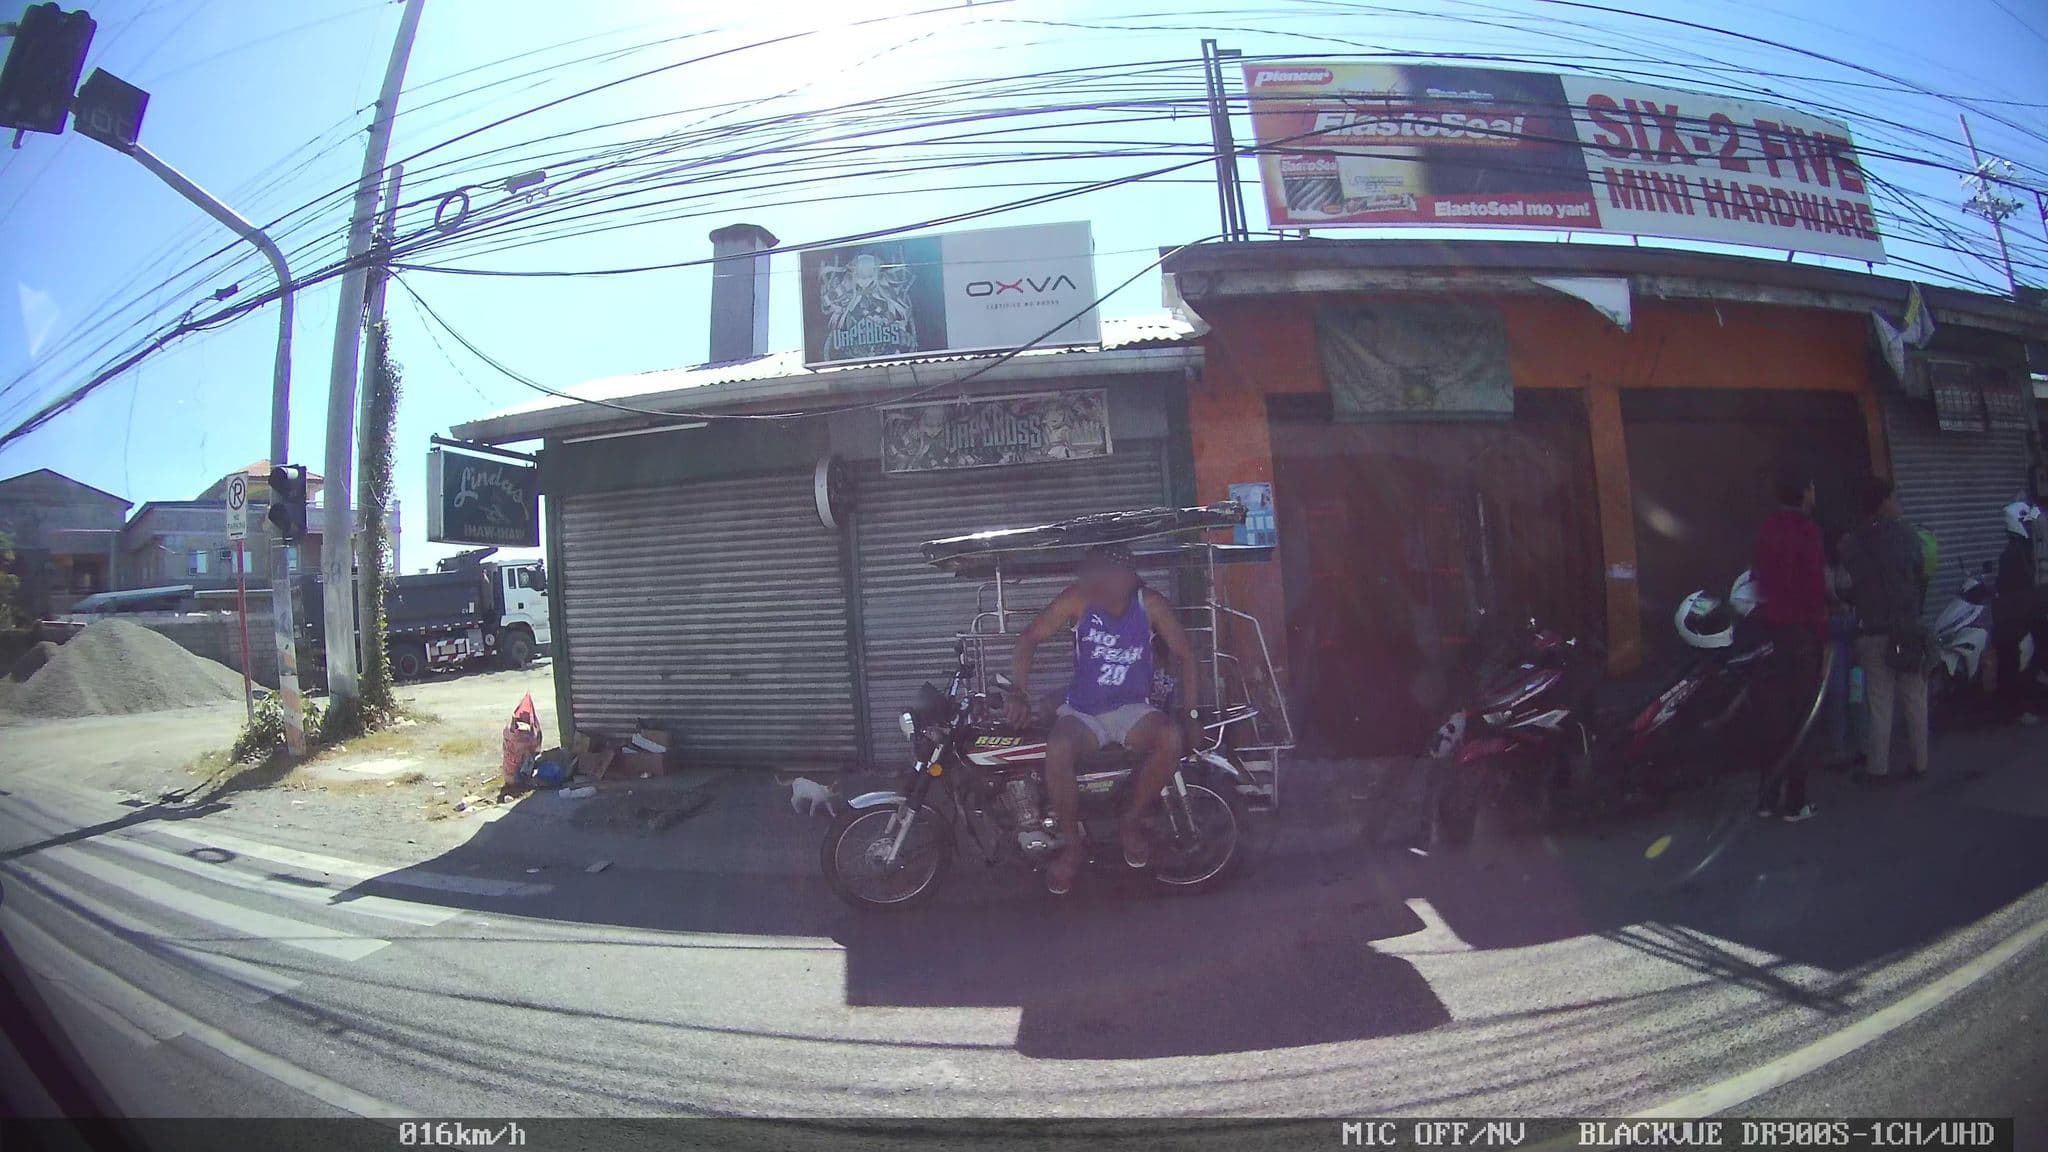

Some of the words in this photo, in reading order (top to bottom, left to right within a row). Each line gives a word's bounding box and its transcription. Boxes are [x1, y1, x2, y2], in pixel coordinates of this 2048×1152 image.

[1313, 109, 1525, 140] ElastoSeal
[1586, 94, 1750, 173] SIX-2
[1753, 118, 1865, 194] FIVE
[1434, 200, 1524, 216] ElastoSeal
[1526, 203, 1554, 216] mo
[1556, 202, 1591, 219] yan!
[1603, 166, 1695, 216] MINI
[1699, 176, 1879, 242] HARDWARE
[966, 275, 1077, 297] OXVA
